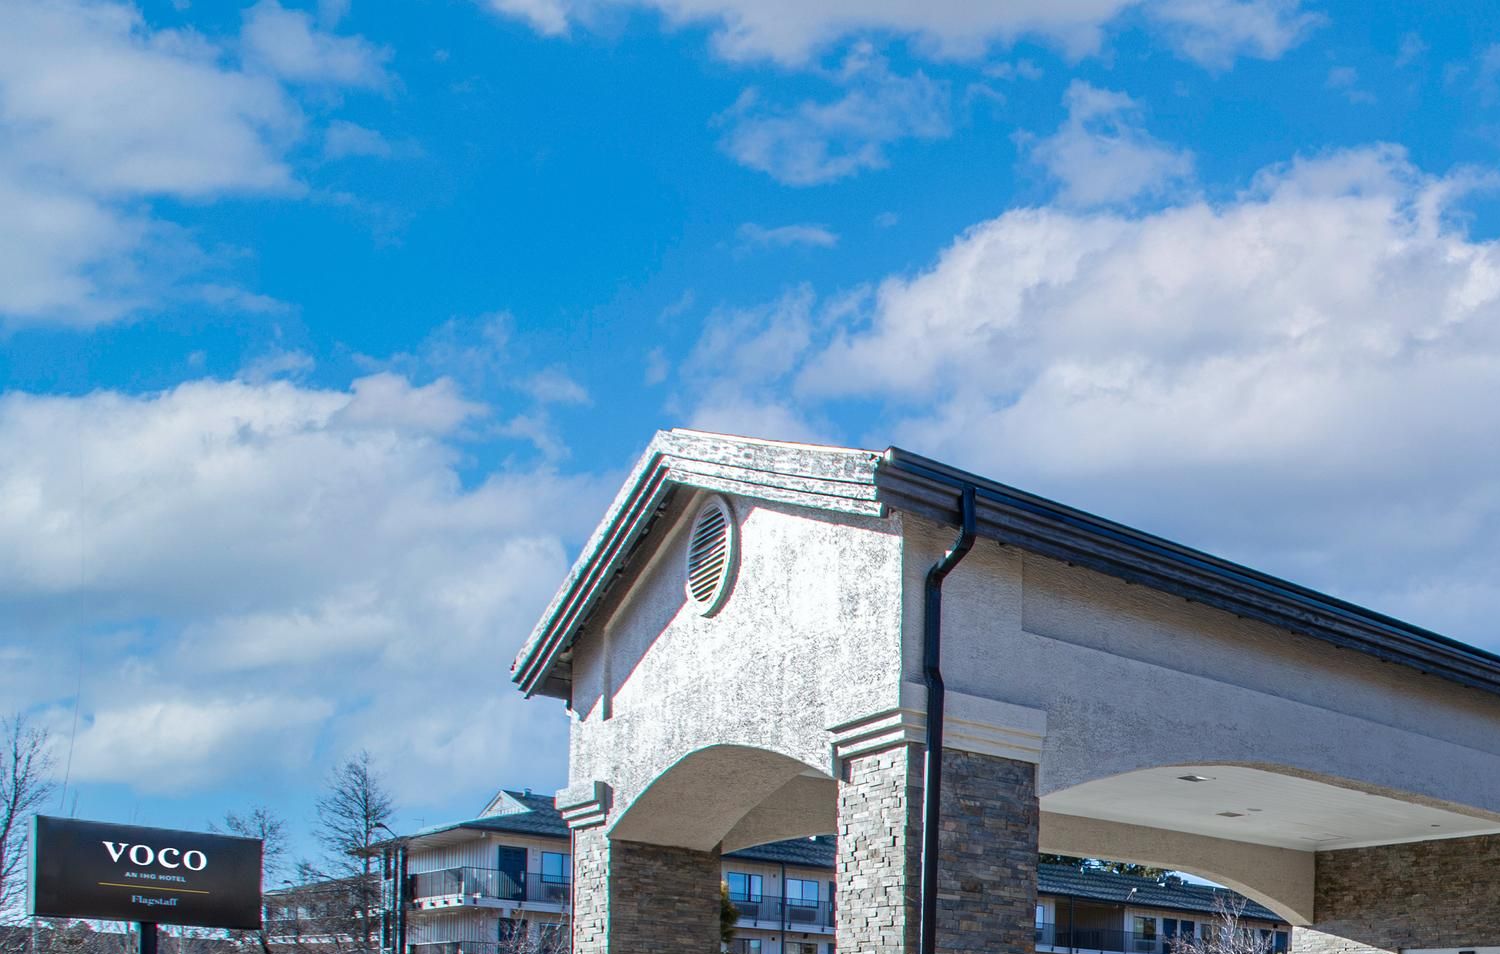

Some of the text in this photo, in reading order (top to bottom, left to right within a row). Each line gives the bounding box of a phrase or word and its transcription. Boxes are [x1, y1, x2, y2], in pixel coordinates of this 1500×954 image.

[140, 872, 157, 880] IHG
[159, 874, 186, 882] HOTEL
[131, 895, 178, 906] Flagstaff
